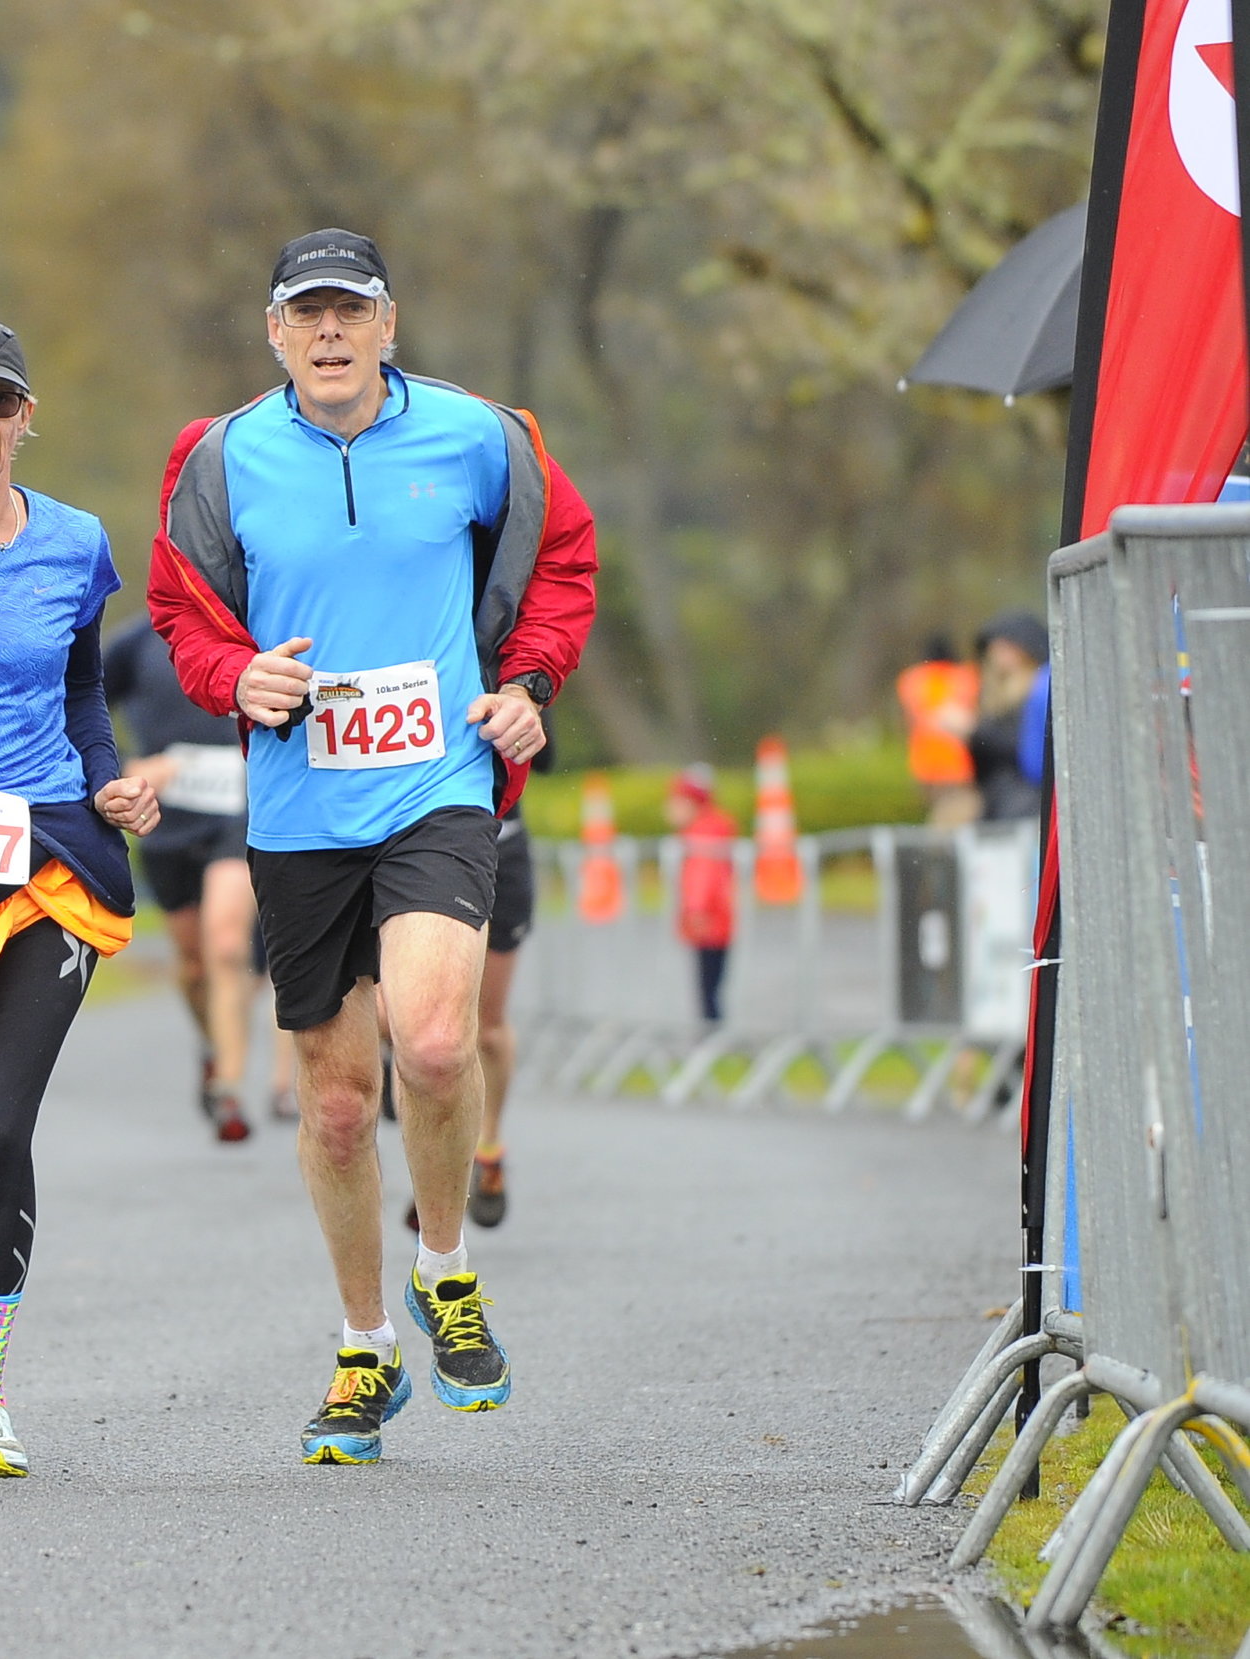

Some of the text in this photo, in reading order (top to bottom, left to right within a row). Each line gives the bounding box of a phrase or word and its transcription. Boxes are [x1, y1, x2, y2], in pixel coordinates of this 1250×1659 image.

[376, 679, 428, 694] 10km Series
[315, 698, 435, 755] 1423
